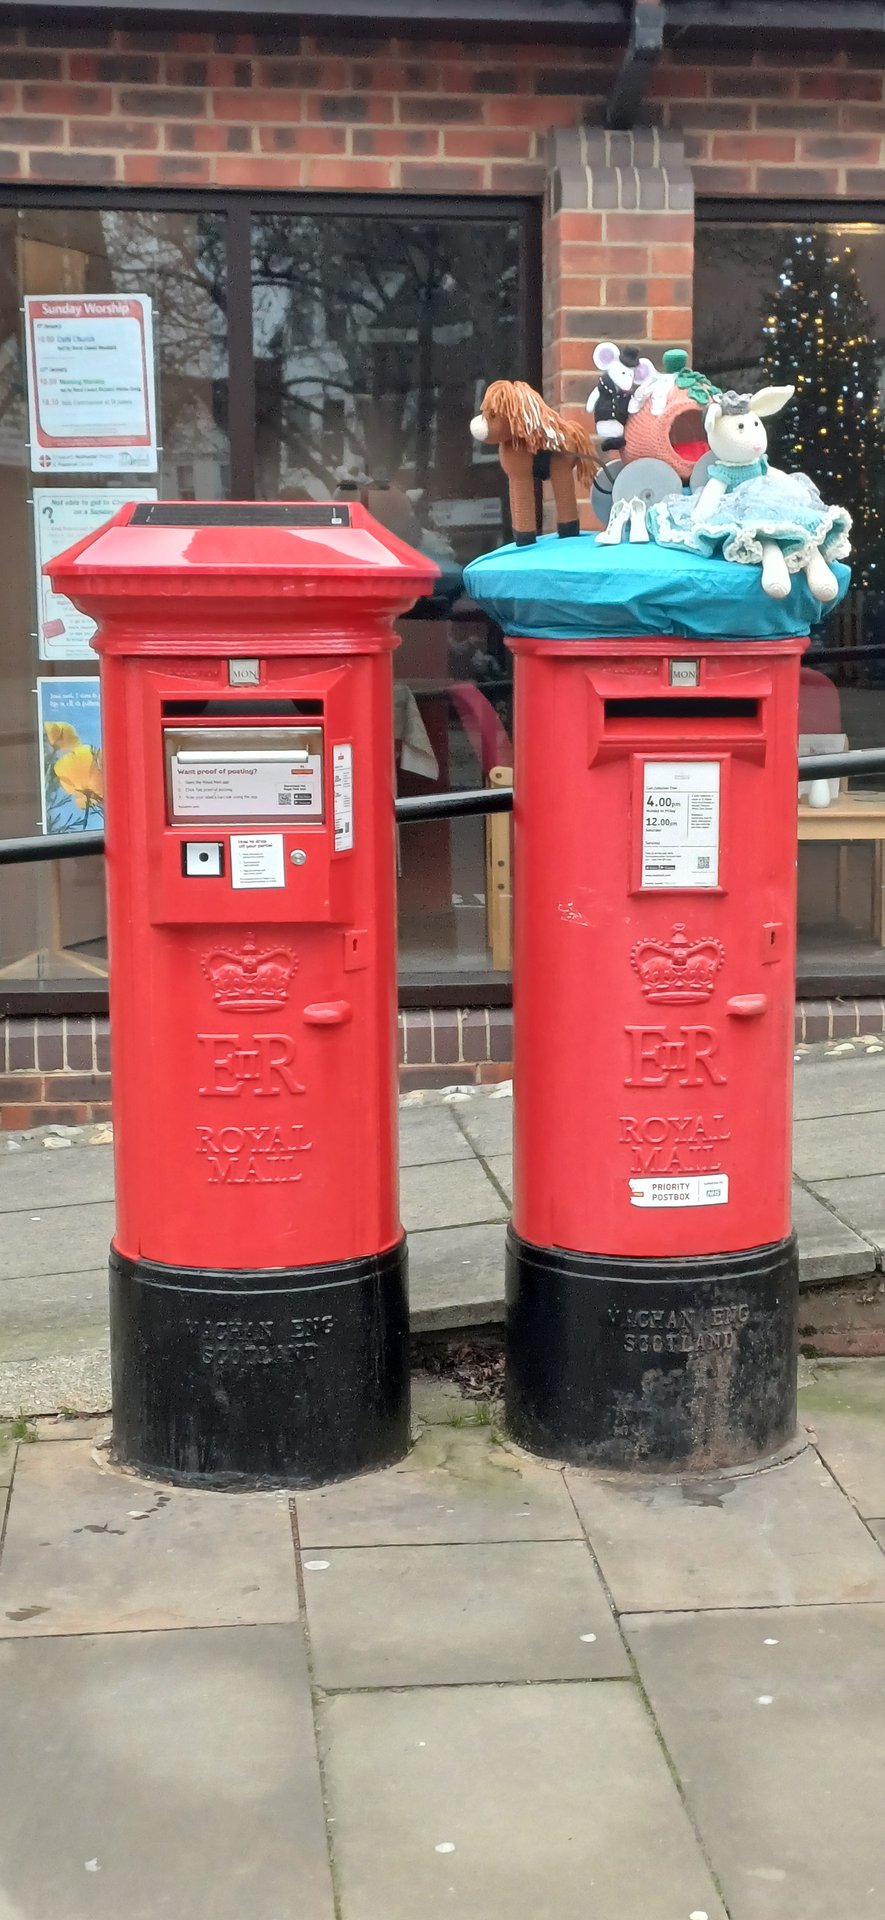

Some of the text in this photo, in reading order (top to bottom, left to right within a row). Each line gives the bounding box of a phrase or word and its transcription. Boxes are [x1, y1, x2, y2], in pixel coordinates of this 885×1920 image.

[42, 302, 130, 316] Sunday Worship
[233, 670, 257, 679] MON
[673, 671, 696, 679] MON
[646, 795, 681, 808] 4.00pm
[646, 817, 678, 826] 12.00pm
[618, 1115, 731, 1144] ROYAL
[195, 1124, 313, 1154] ROYAL
[630, 1144, 722, 1174] MAIL
[207, 1154, 303, 1184] MAIL
[651, 1183, 691, 1191] PRIORITY
[651, 1193, 691, 1201] POSTBOX
[711, 1302, 750, 1327] ENG
[623, 1331, 735, 1353] SCOTLAND
